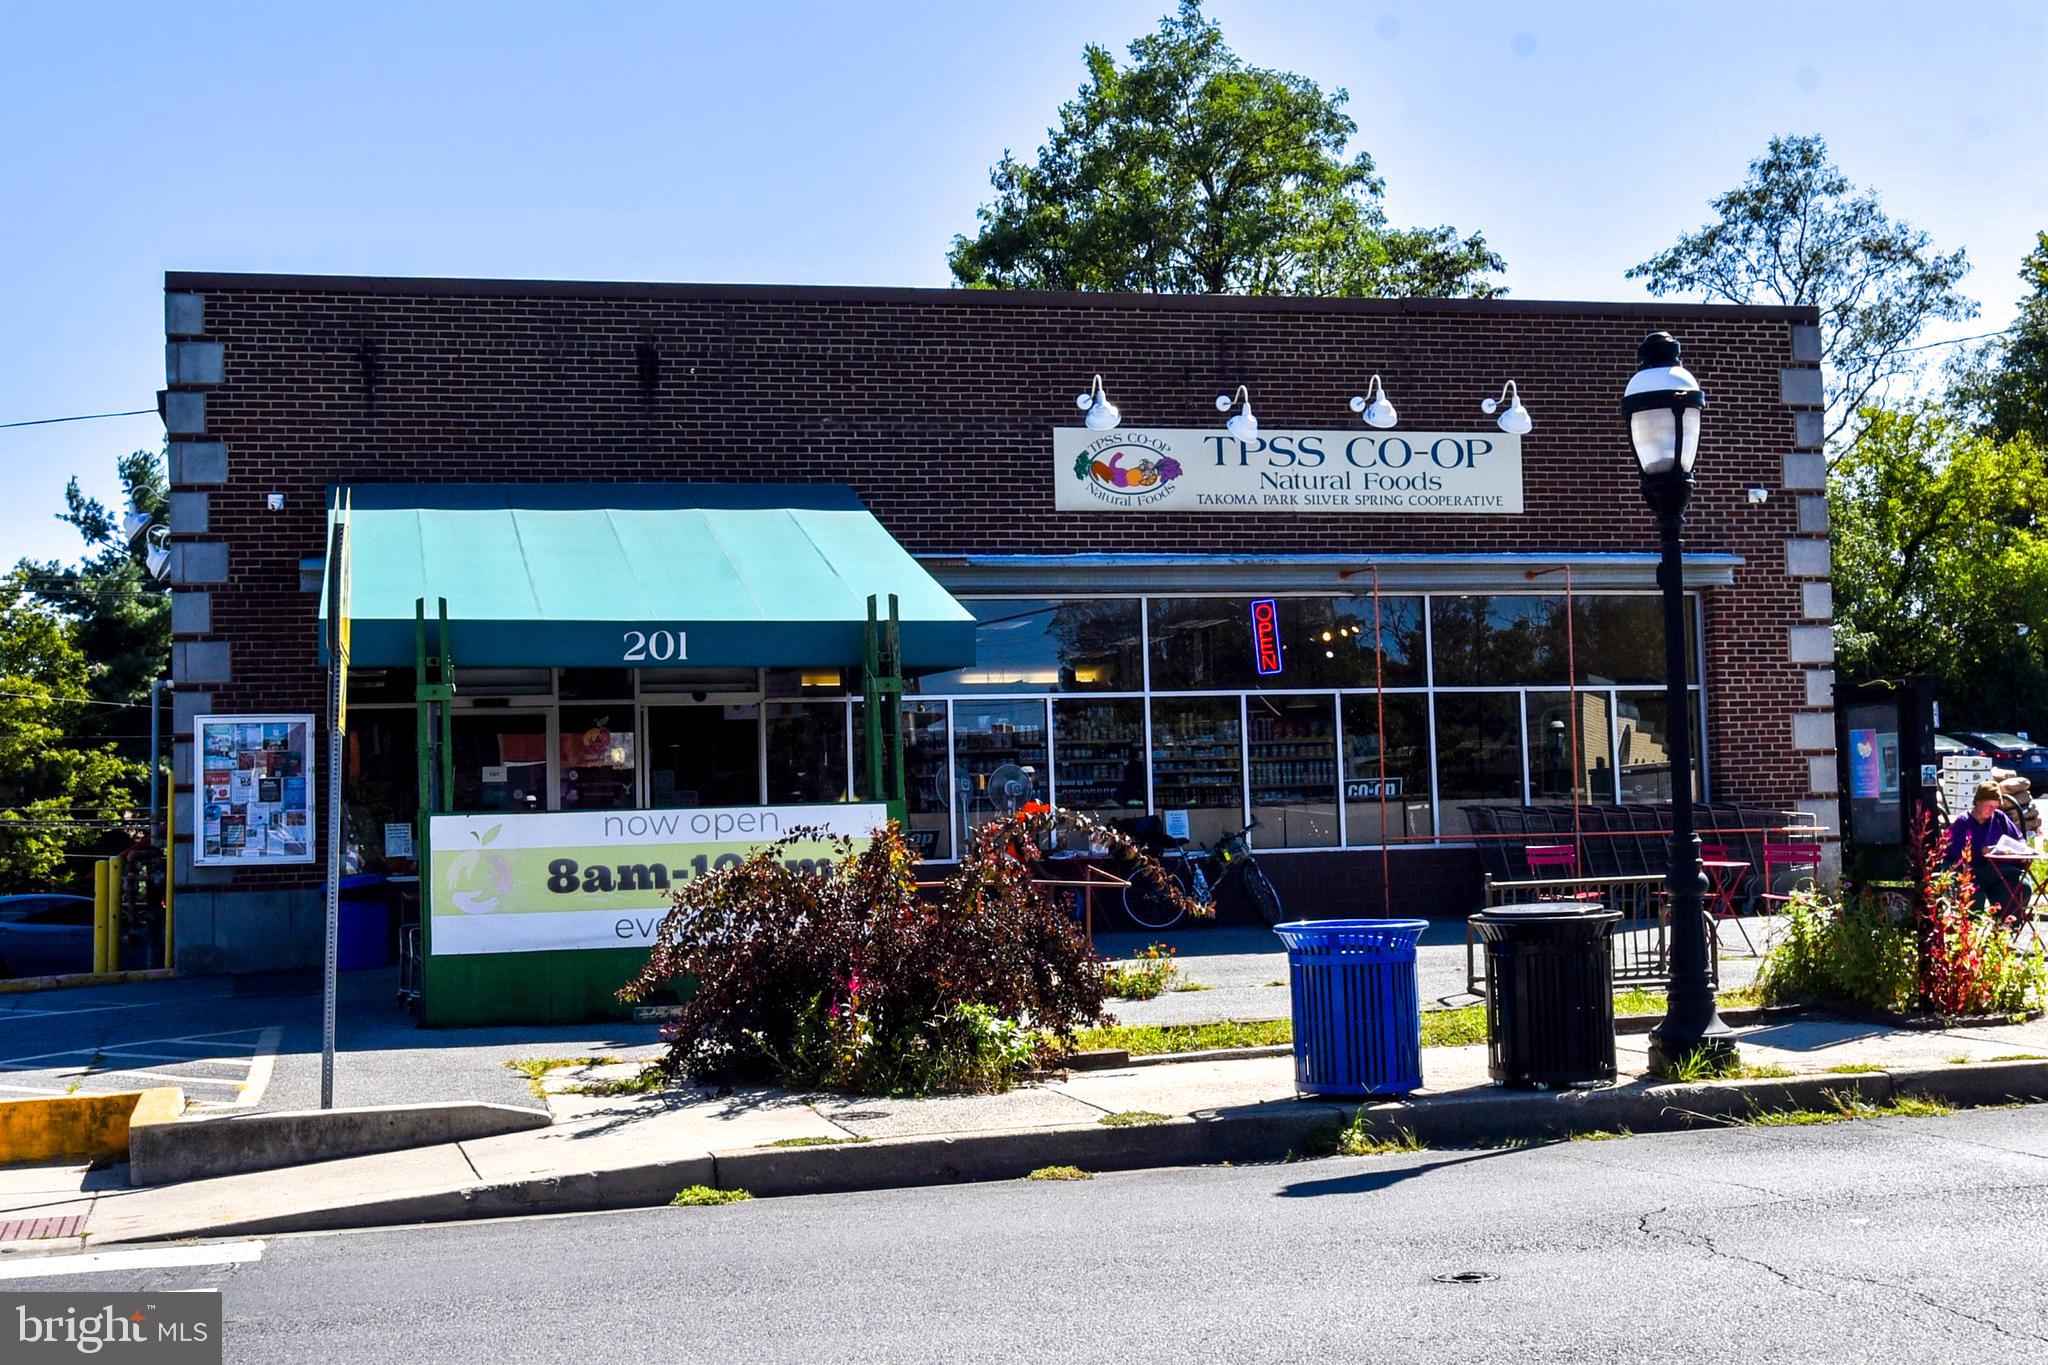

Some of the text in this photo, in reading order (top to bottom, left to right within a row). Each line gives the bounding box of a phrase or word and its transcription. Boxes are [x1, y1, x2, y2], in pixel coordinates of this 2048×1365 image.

[1087, 432, 1171, 453] TPSS CO-OP
[1204, 436, 1493, 469] TPSS CO-OP
[1085, 482, 1176, 507] Natural Foods
[1260, 471, 1442, 491] Natural Foods
[1196, 493, 1504, 507] TAKOMA PARK SILVER SPRING COOPERATIVE
[623, 630, 688, 662] 201
[1255, 603, 1278, 671] OPEN
[604, 811, 779, 840] now open
